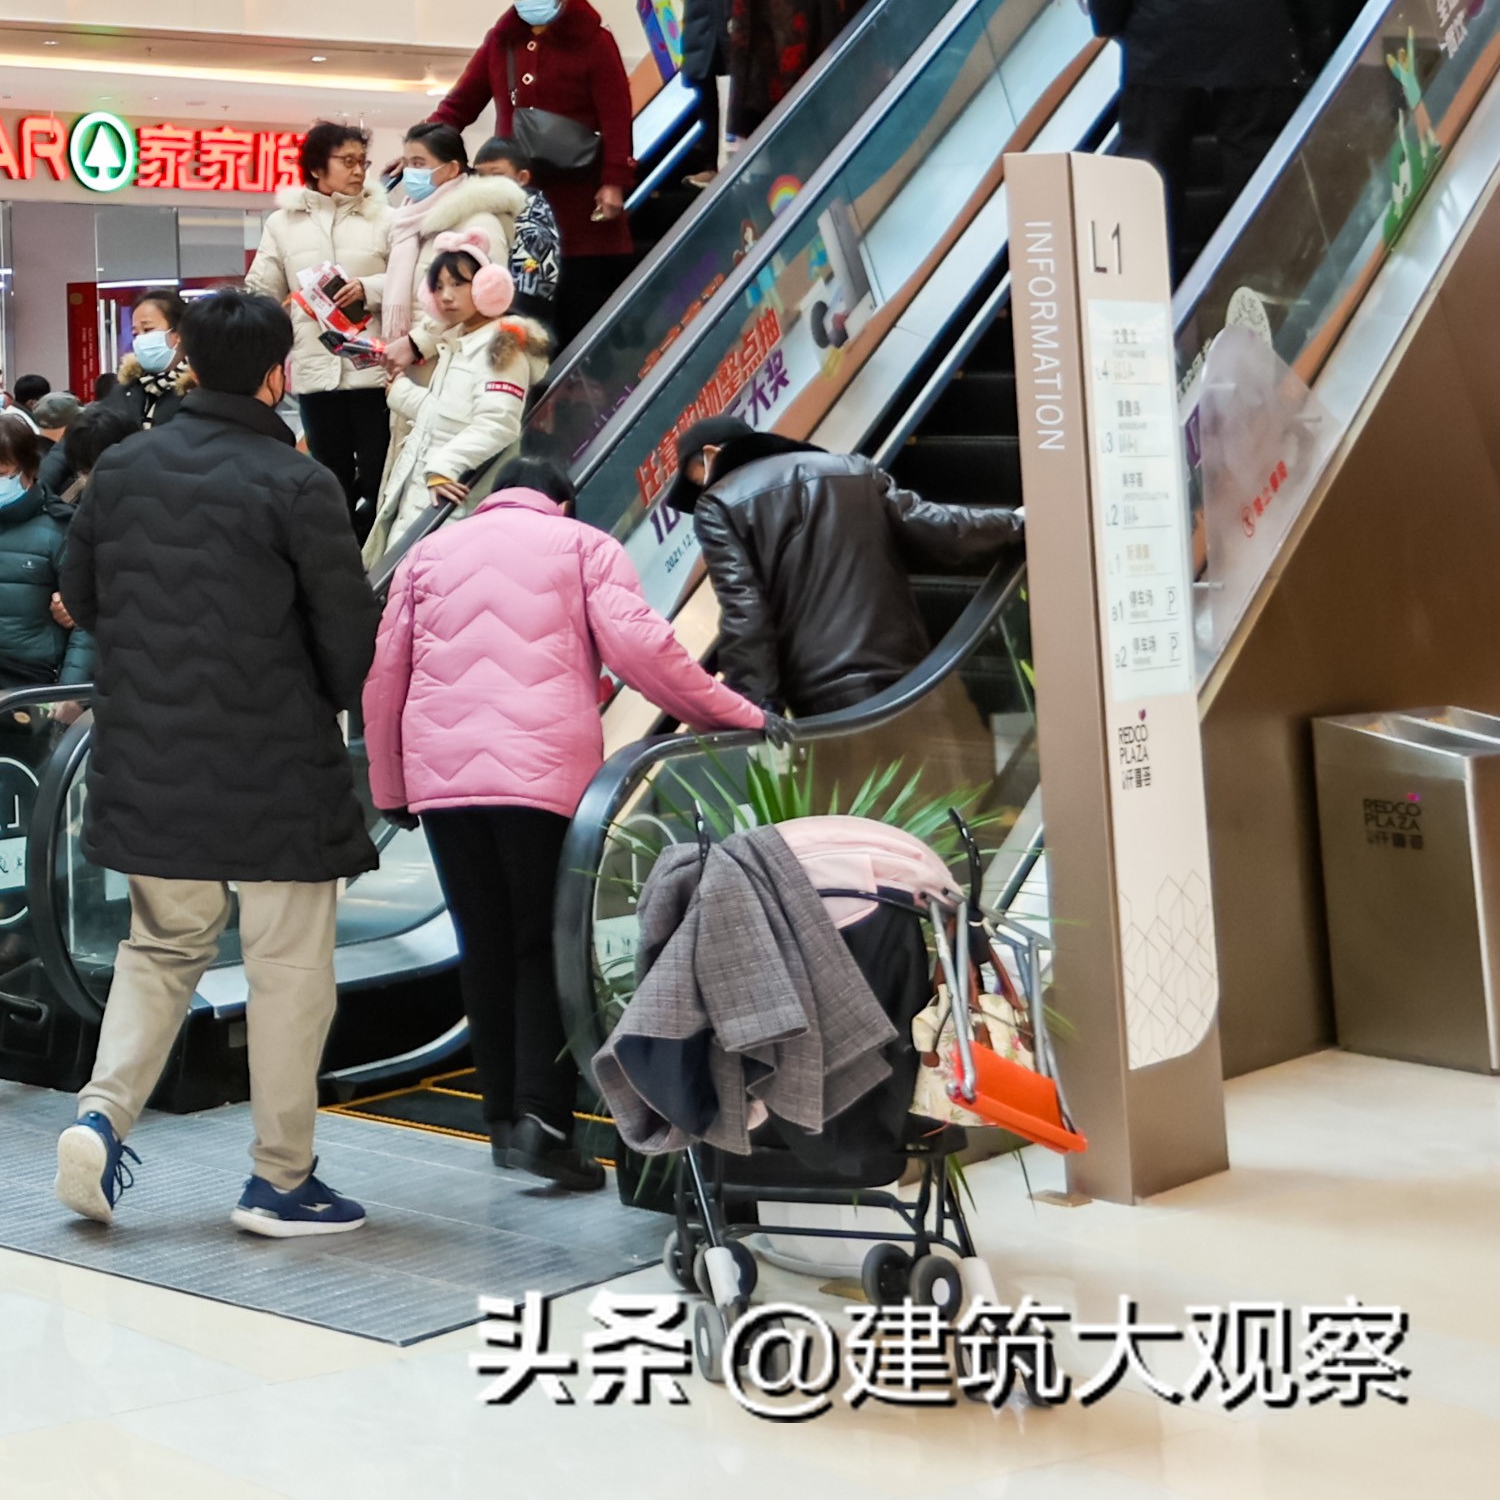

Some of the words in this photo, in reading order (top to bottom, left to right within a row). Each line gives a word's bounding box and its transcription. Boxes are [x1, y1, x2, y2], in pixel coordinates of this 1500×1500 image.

[1090, 220, 1122, 275] L1
[1024, 221, 1066, 451] INFORMATION
[1119, 743, 1149, 765] PLAZA
